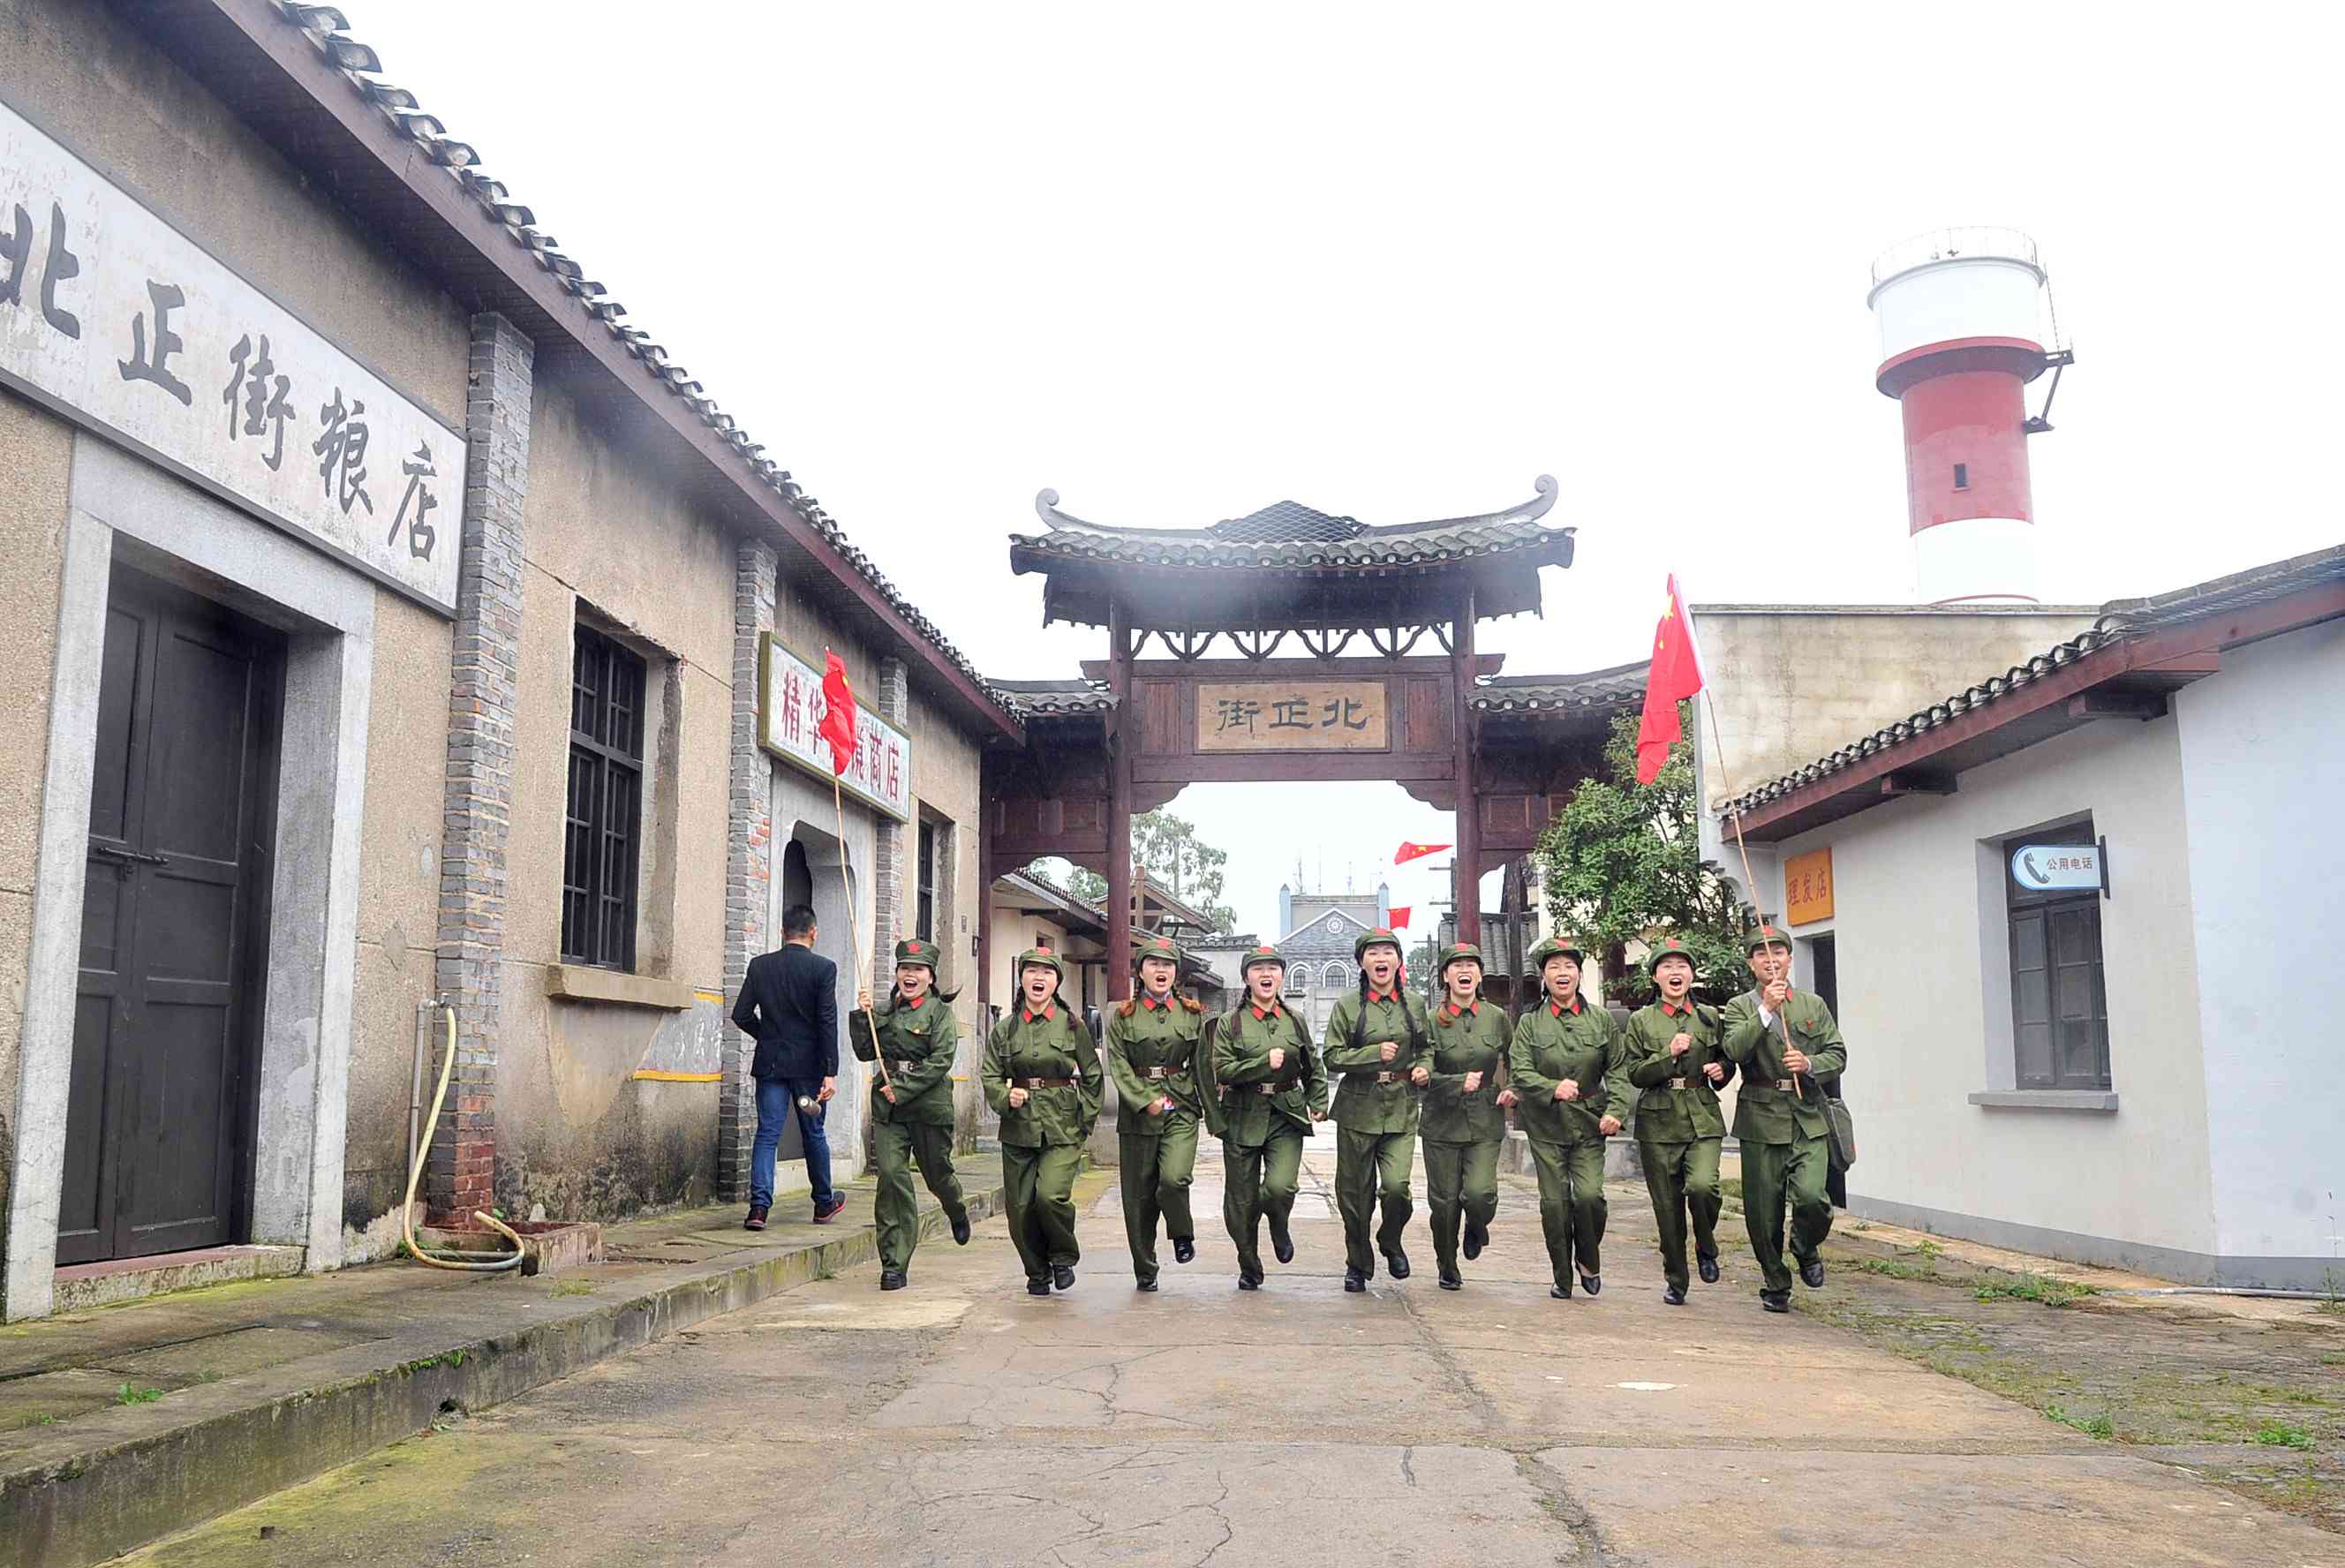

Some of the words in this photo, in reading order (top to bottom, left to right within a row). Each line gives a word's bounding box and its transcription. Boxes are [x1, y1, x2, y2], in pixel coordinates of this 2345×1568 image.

[0, 202, 438, 562] 北正街粮店
[2047, 856, 2093, 871] 公用电话
